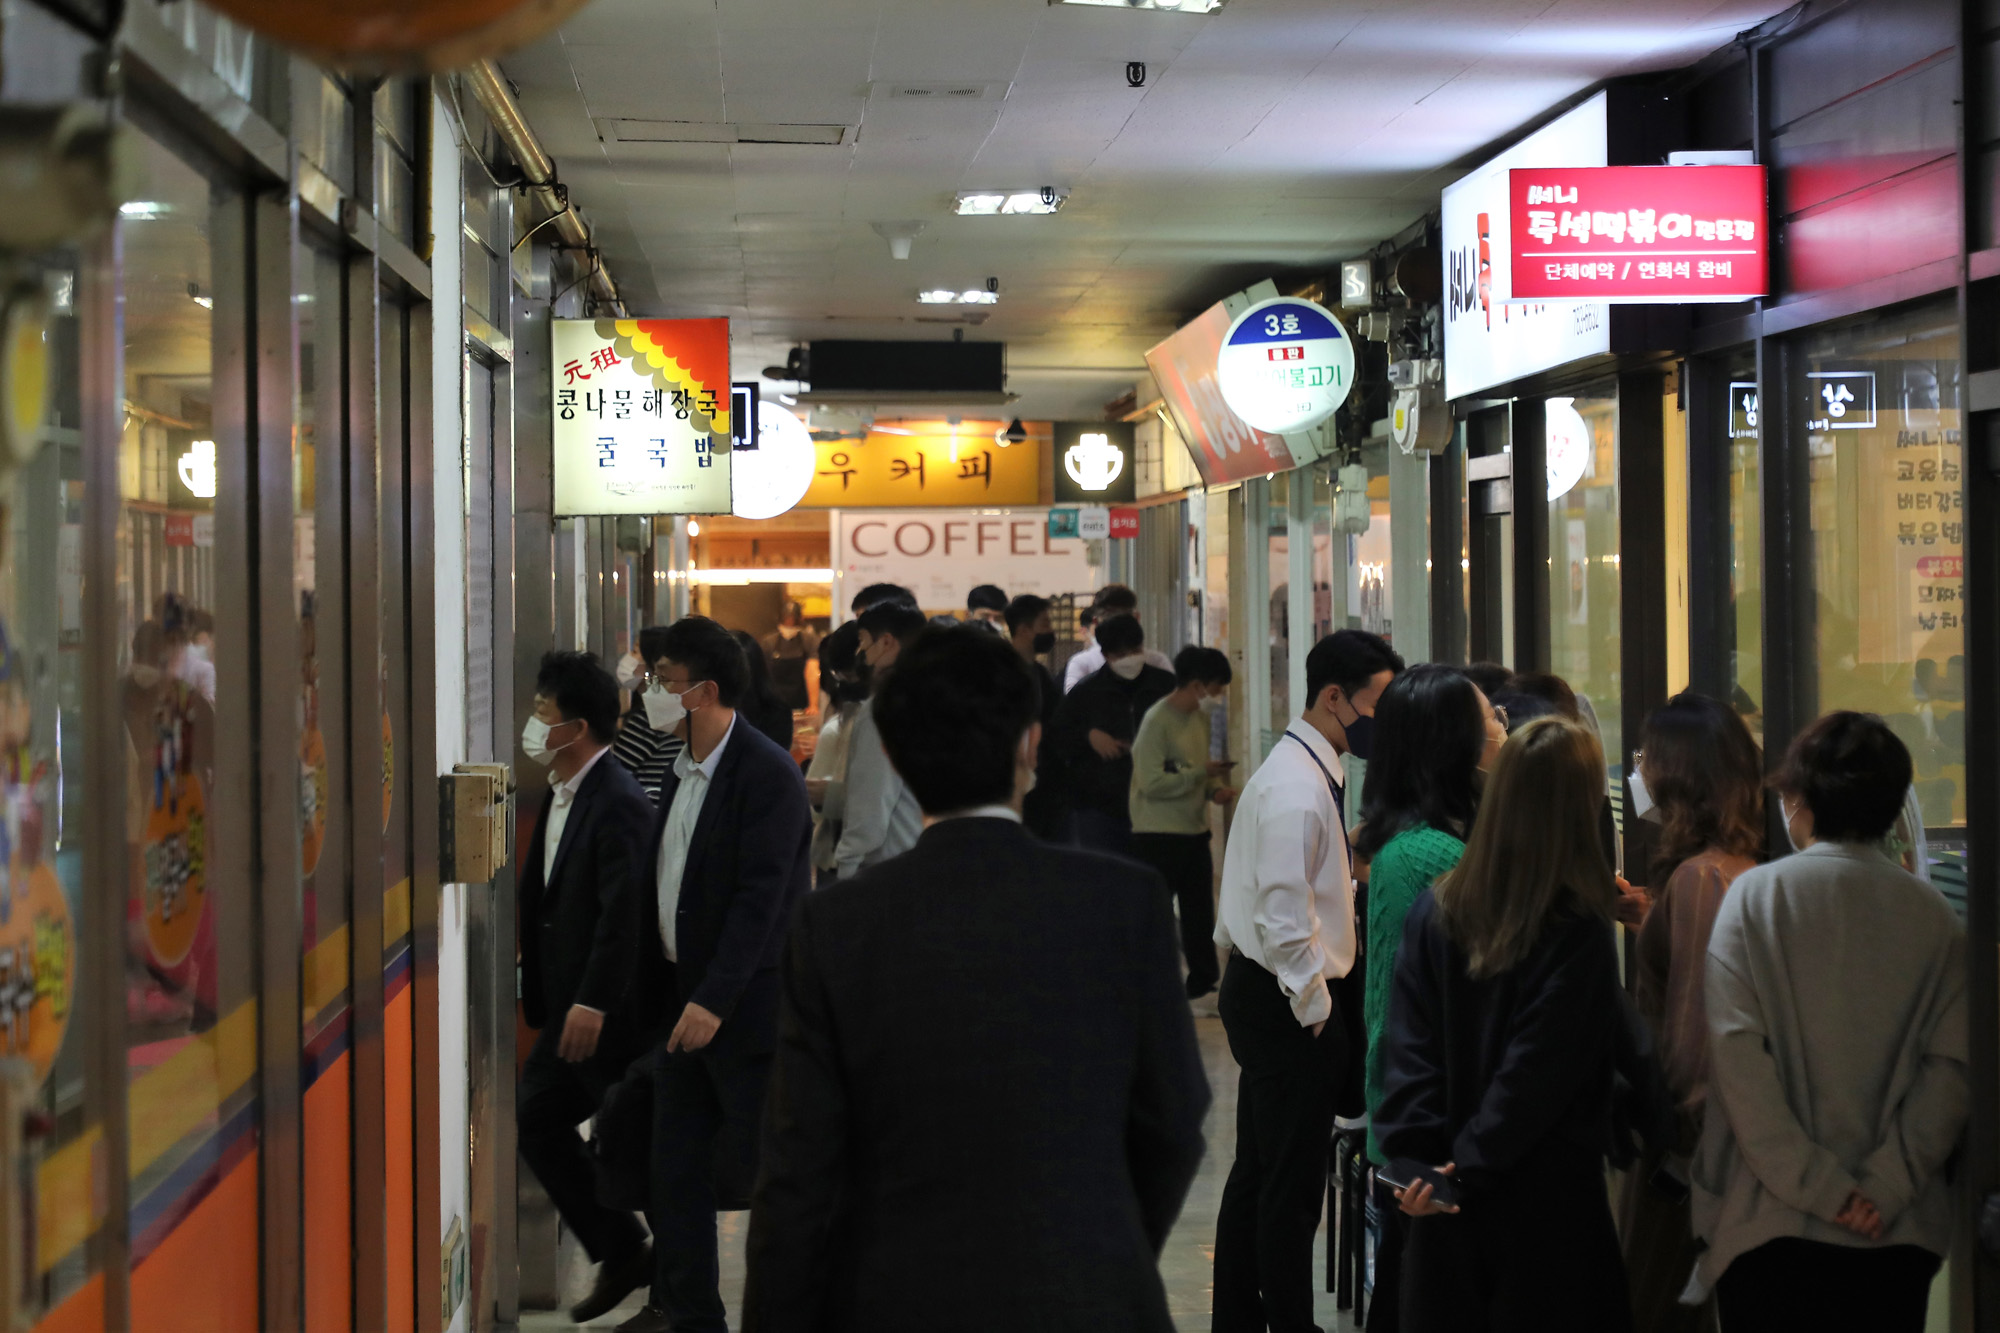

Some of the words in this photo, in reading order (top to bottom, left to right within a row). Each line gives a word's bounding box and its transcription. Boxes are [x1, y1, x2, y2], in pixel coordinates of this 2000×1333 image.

[1527, 185, 1578, 205] 써니
[1545, 263, 1615, 281] 단체예약
[1638, 261, 1690, 280] 연회석
[1697, 260, 1733, 279] 완비
[1264, 313, 1302, 337] 3호
[563, 346, 622, 386] 元祖
[1259, 365, 1342, 389] 어불고기
[556, 388, 720, 421] 콩나물해장국
[1918, 612, 1964, 631] 날치
